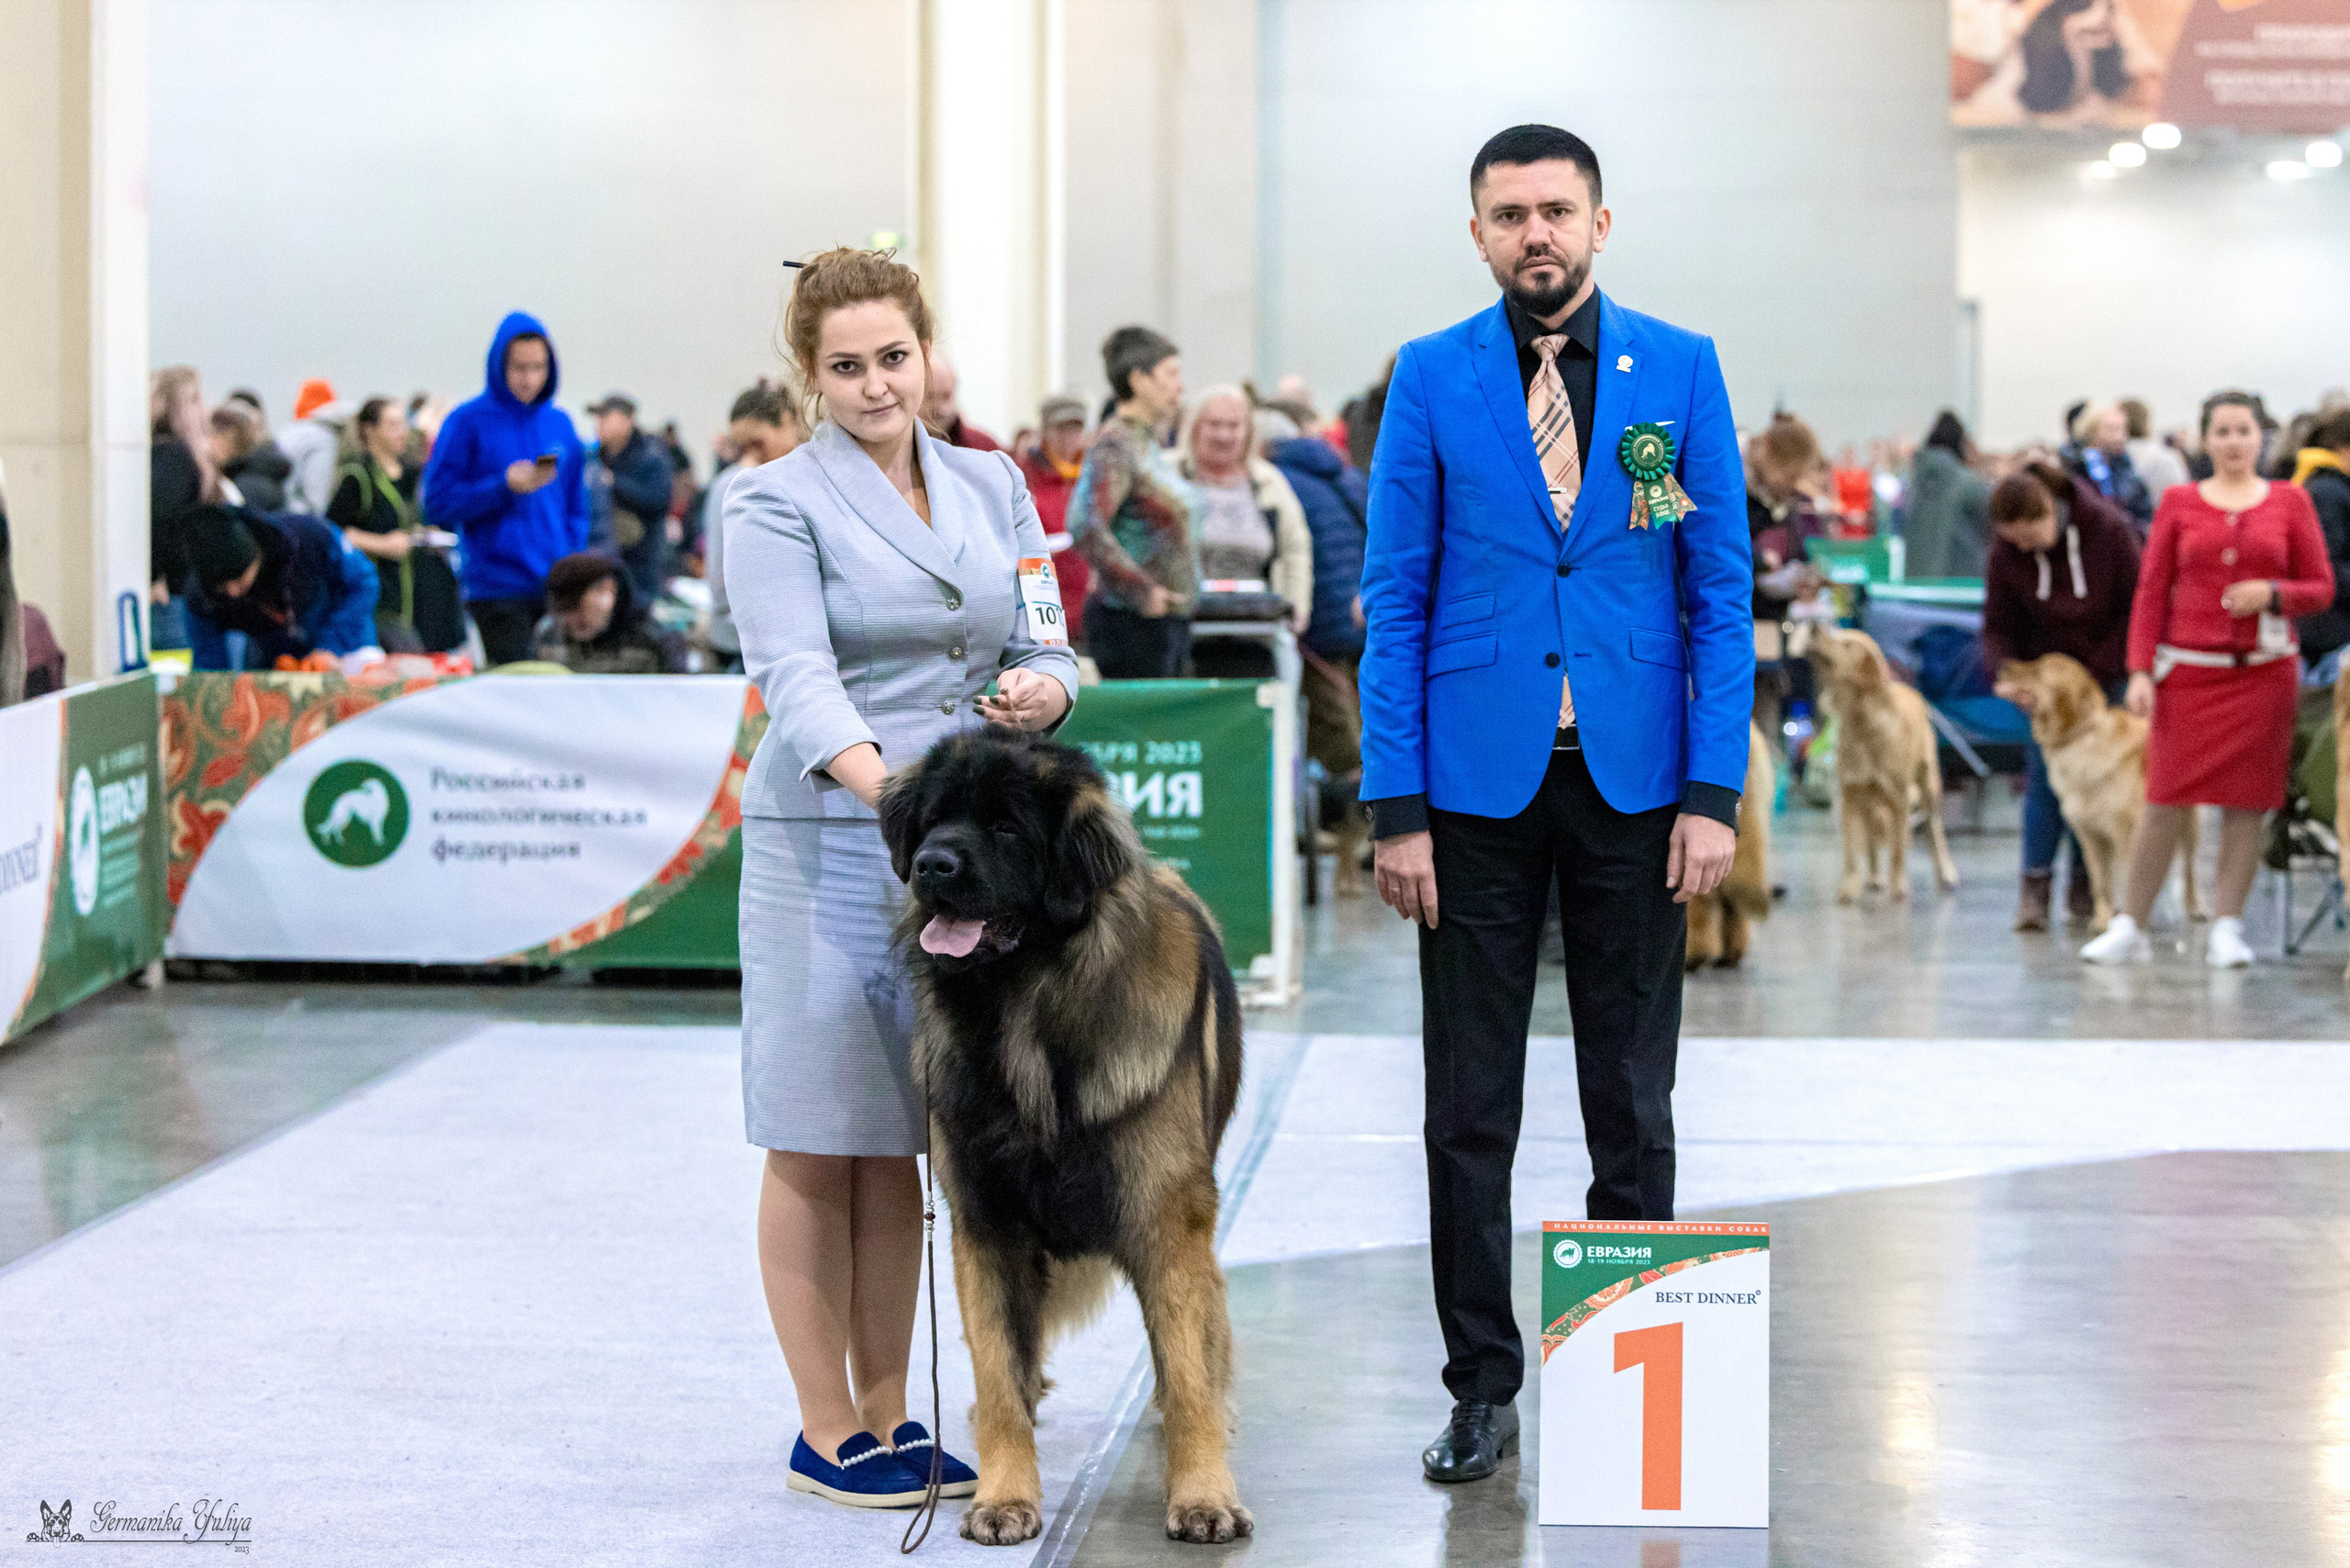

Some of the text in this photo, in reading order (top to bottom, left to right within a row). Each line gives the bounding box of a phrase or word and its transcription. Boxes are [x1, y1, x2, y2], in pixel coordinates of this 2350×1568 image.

[431, 835, 581, 865] федерация
[1554, 1223, 1651, 1231] НАЦИОНАЛЬНЫЕ
[1586, 1246, 1651, 1259] ЕВРАЗИЯ
[1655, 1292, 1694, 1304] BEST
[1614, 1321, 1684, 1511] 1
